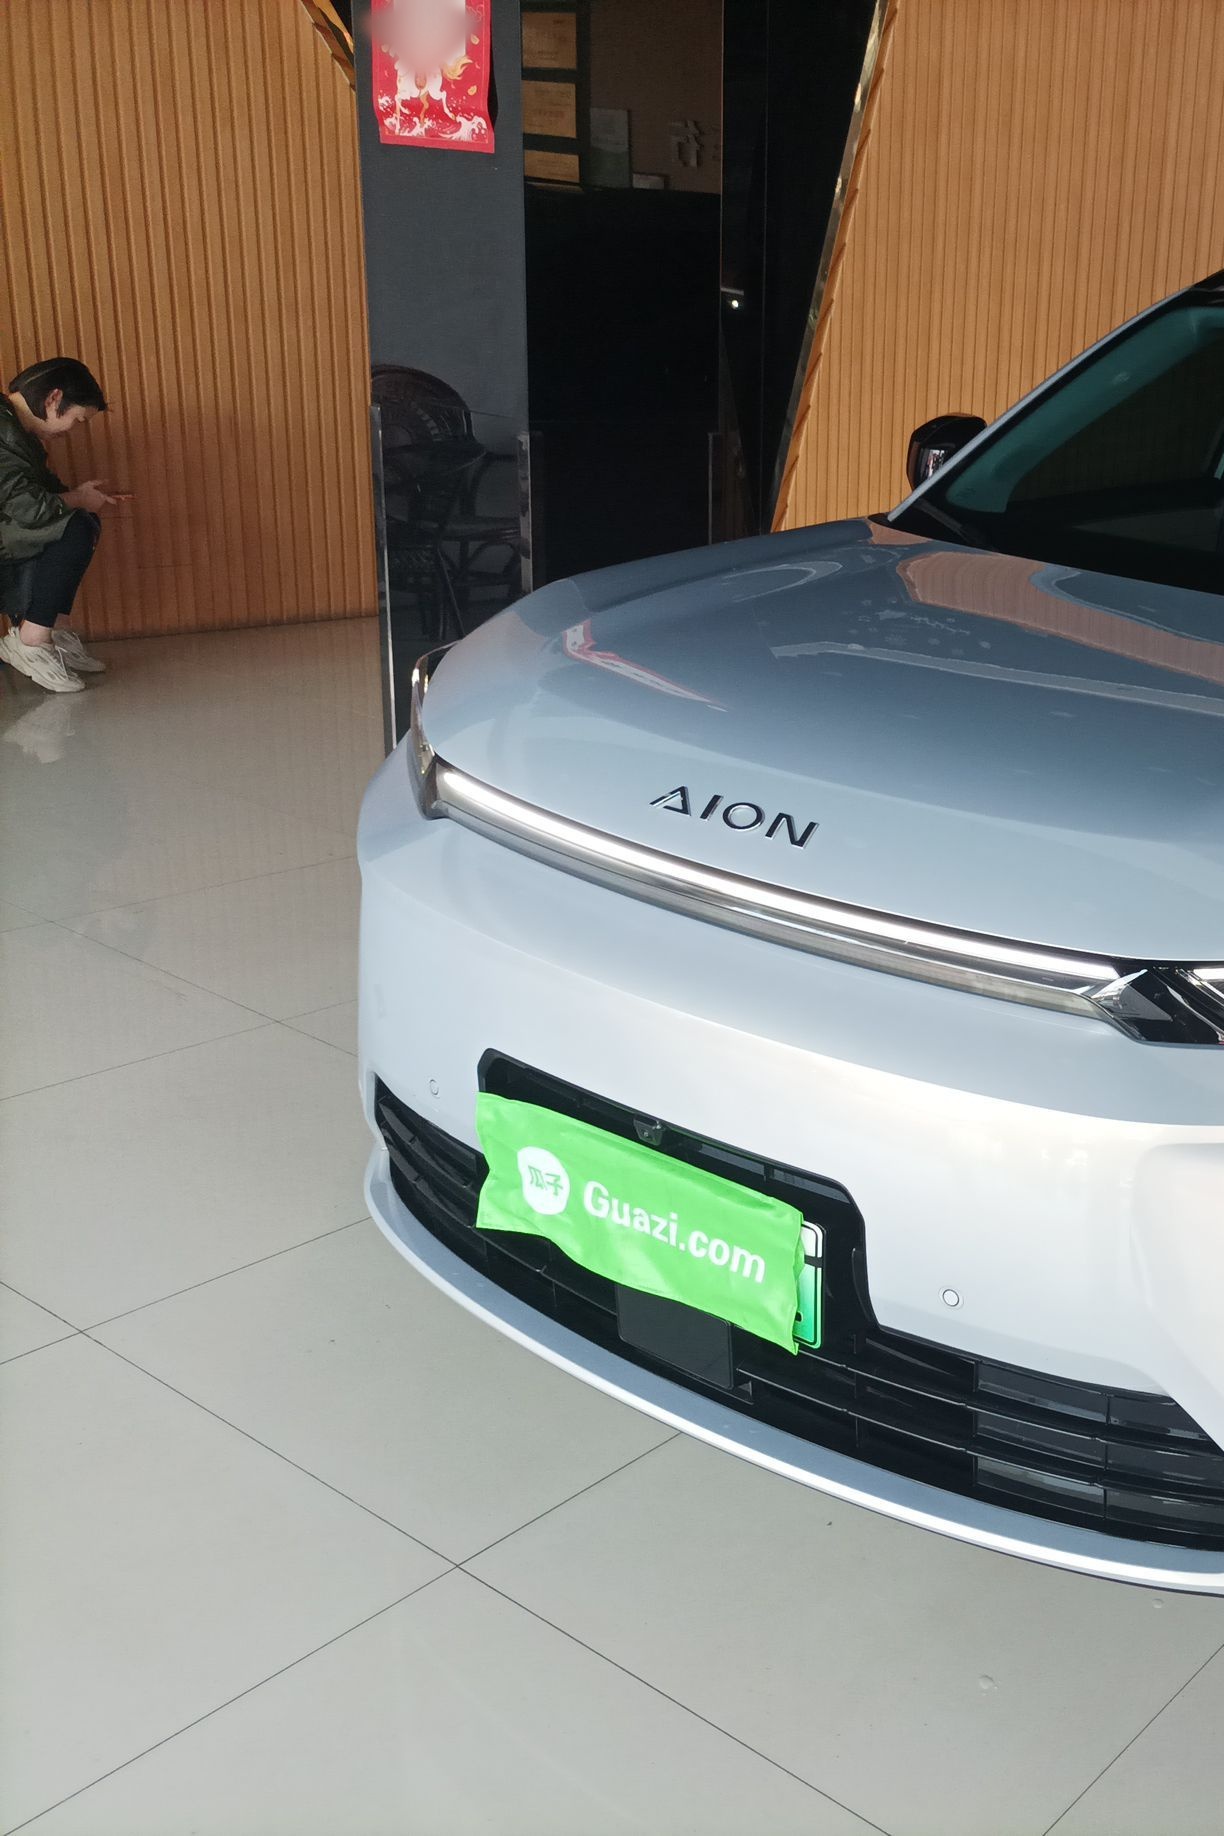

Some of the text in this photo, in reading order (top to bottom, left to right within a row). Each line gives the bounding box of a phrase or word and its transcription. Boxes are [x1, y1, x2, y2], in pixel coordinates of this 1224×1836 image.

[649, 785, 820, 850] AION
[527, 1165, 564, 1197] 瓜子
[583, 1180, 766, 1284] Guazi.com
